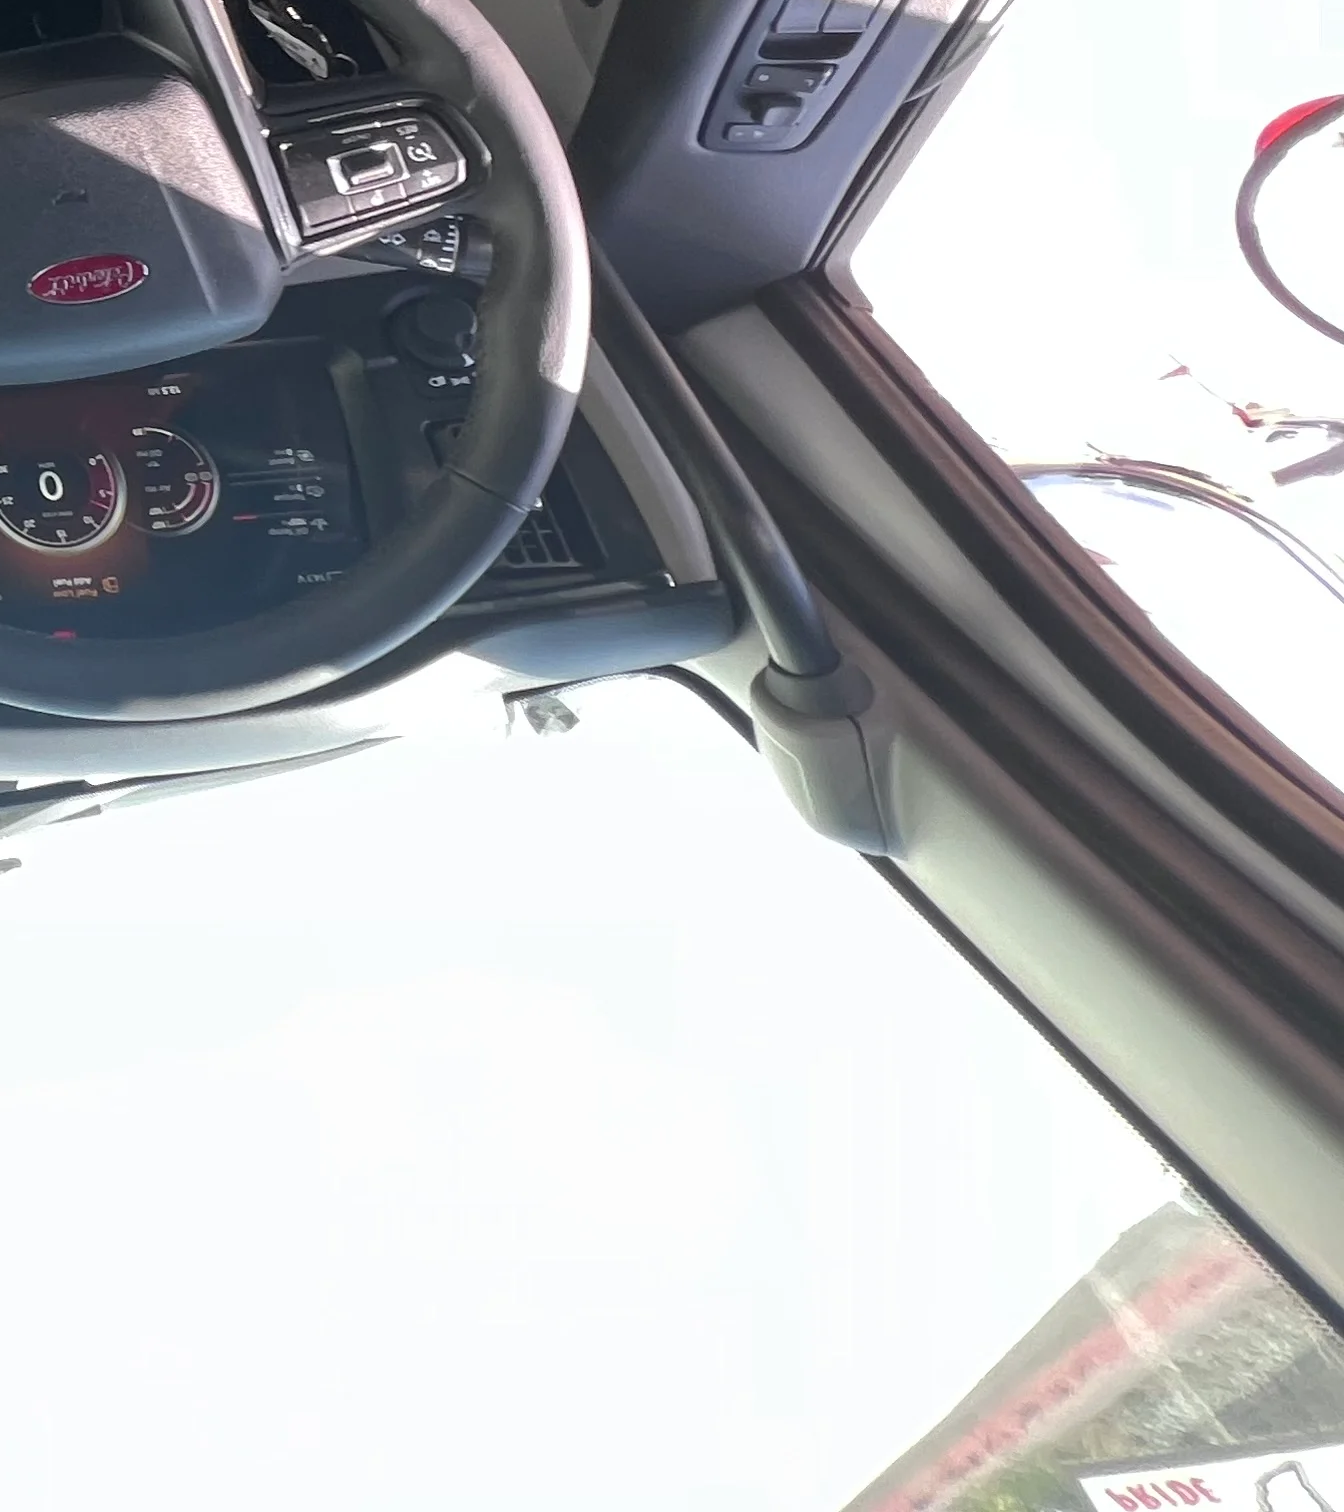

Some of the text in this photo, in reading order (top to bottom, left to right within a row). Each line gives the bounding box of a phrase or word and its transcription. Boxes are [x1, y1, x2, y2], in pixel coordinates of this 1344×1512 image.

[42, 262, 133, 297] Peterbilt
[38, 470, 64, 501] 0
[53, 577, 92, 587] Add Fuel
[53, 588, 98, 598] Fuel Low
